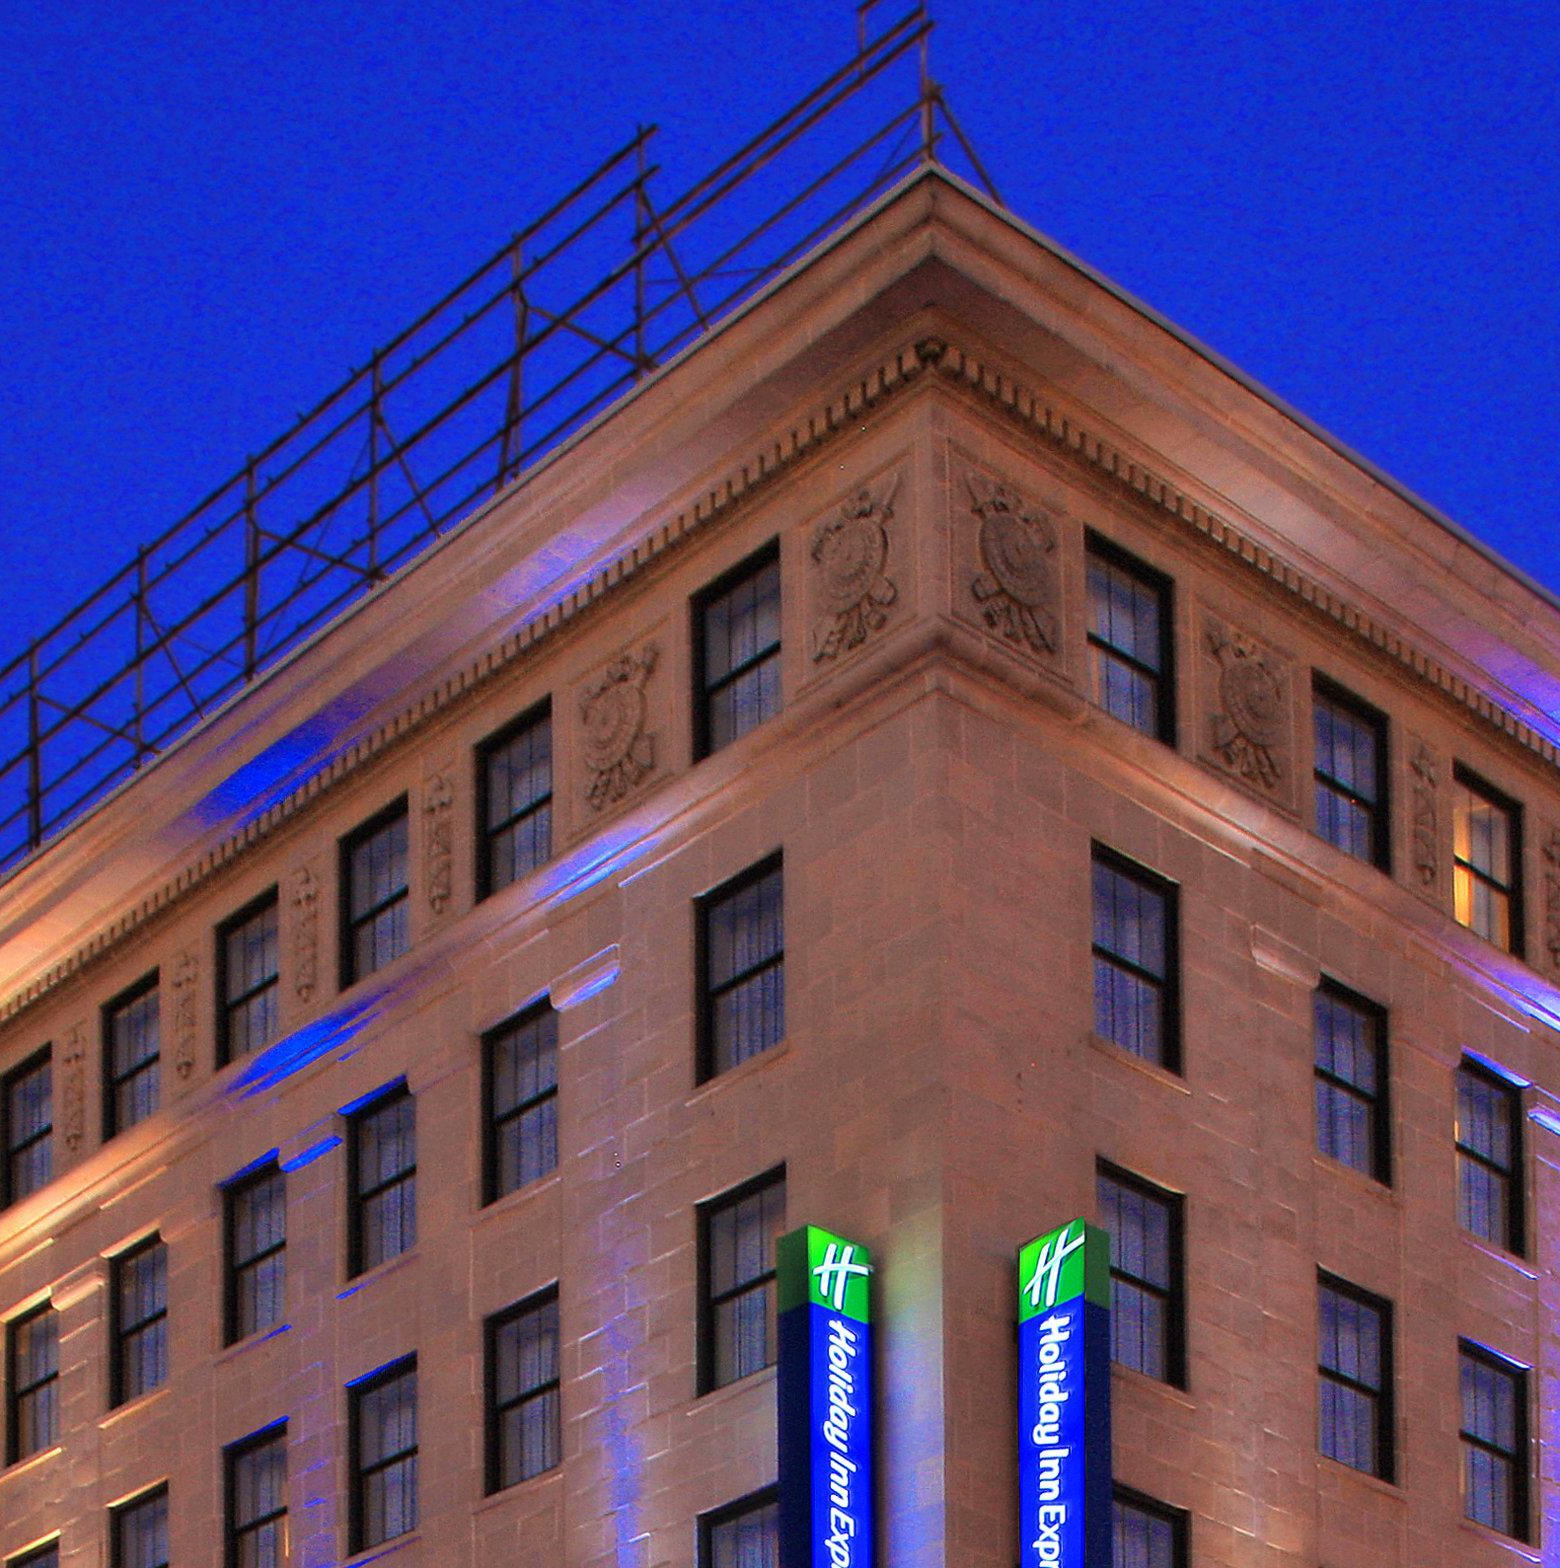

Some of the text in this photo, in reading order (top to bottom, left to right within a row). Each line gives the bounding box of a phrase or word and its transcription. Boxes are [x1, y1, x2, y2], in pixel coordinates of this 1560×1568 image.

[823, 1318, 858, 1452] Holiday
[1032, 1314, 1071, 1444] Holiday
[826, 1449, 858, 1508] Inn
[1037, 1445, 1071, 1500] Inn
